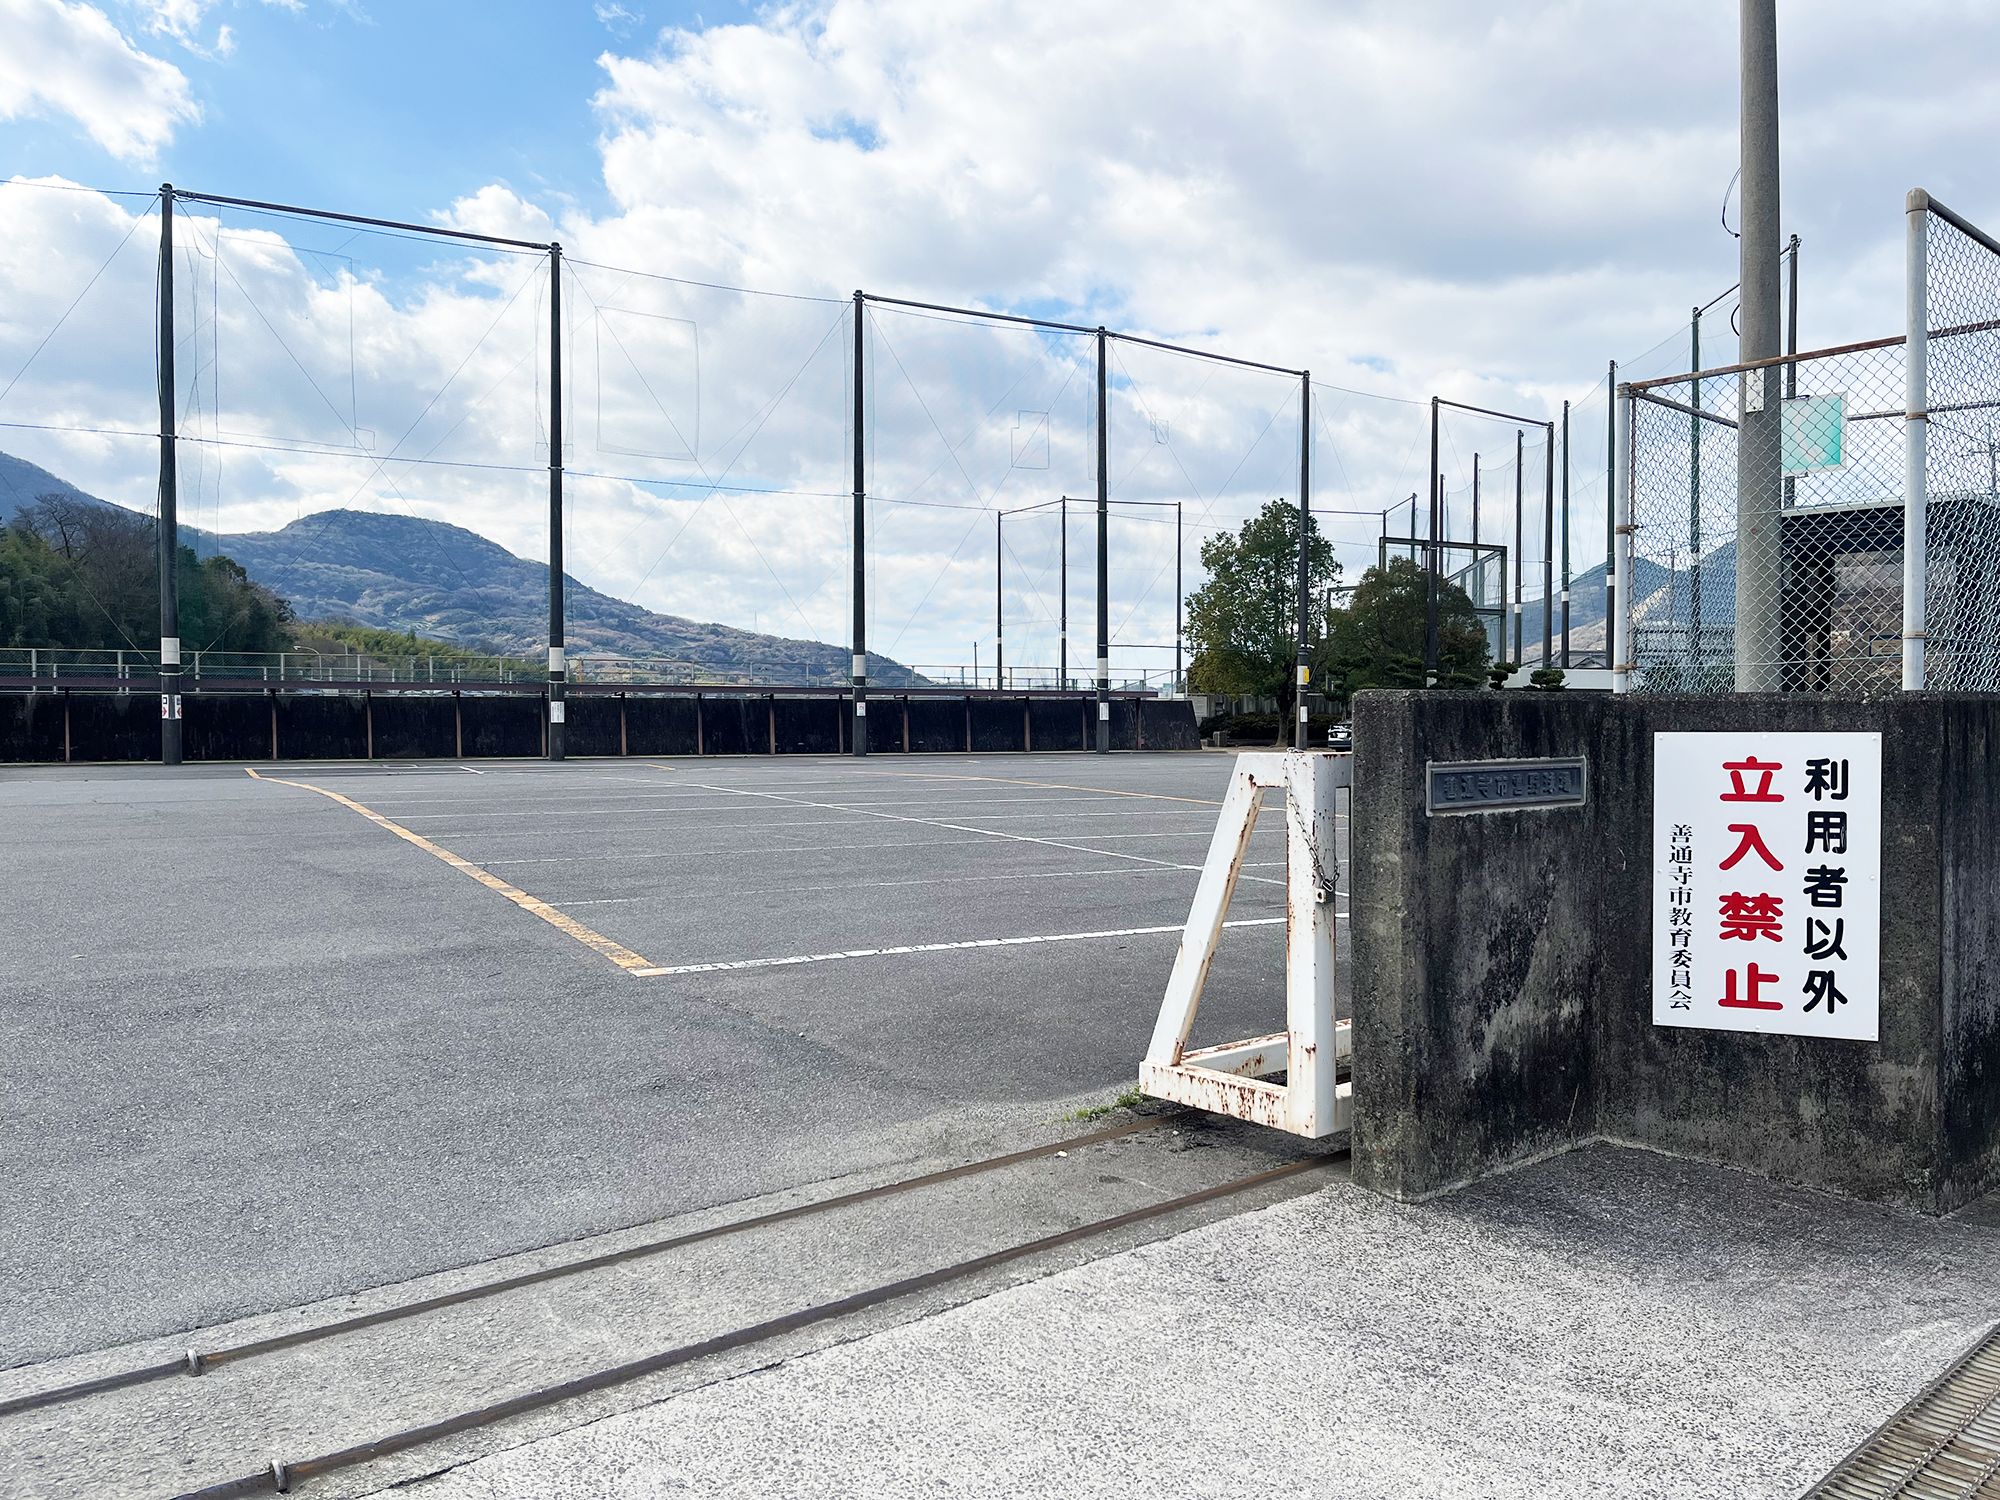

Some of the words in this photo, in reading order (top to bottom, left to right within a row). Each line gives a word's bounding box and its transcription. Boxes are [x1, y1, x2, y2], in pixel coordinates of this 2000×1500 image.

[1668, 823, 1693, 1011] 善通寺市教育委員会
[1717, 755, 1785, 1011] 立入禁止
[1802, 757, 1849, 1014] 利用者以外
